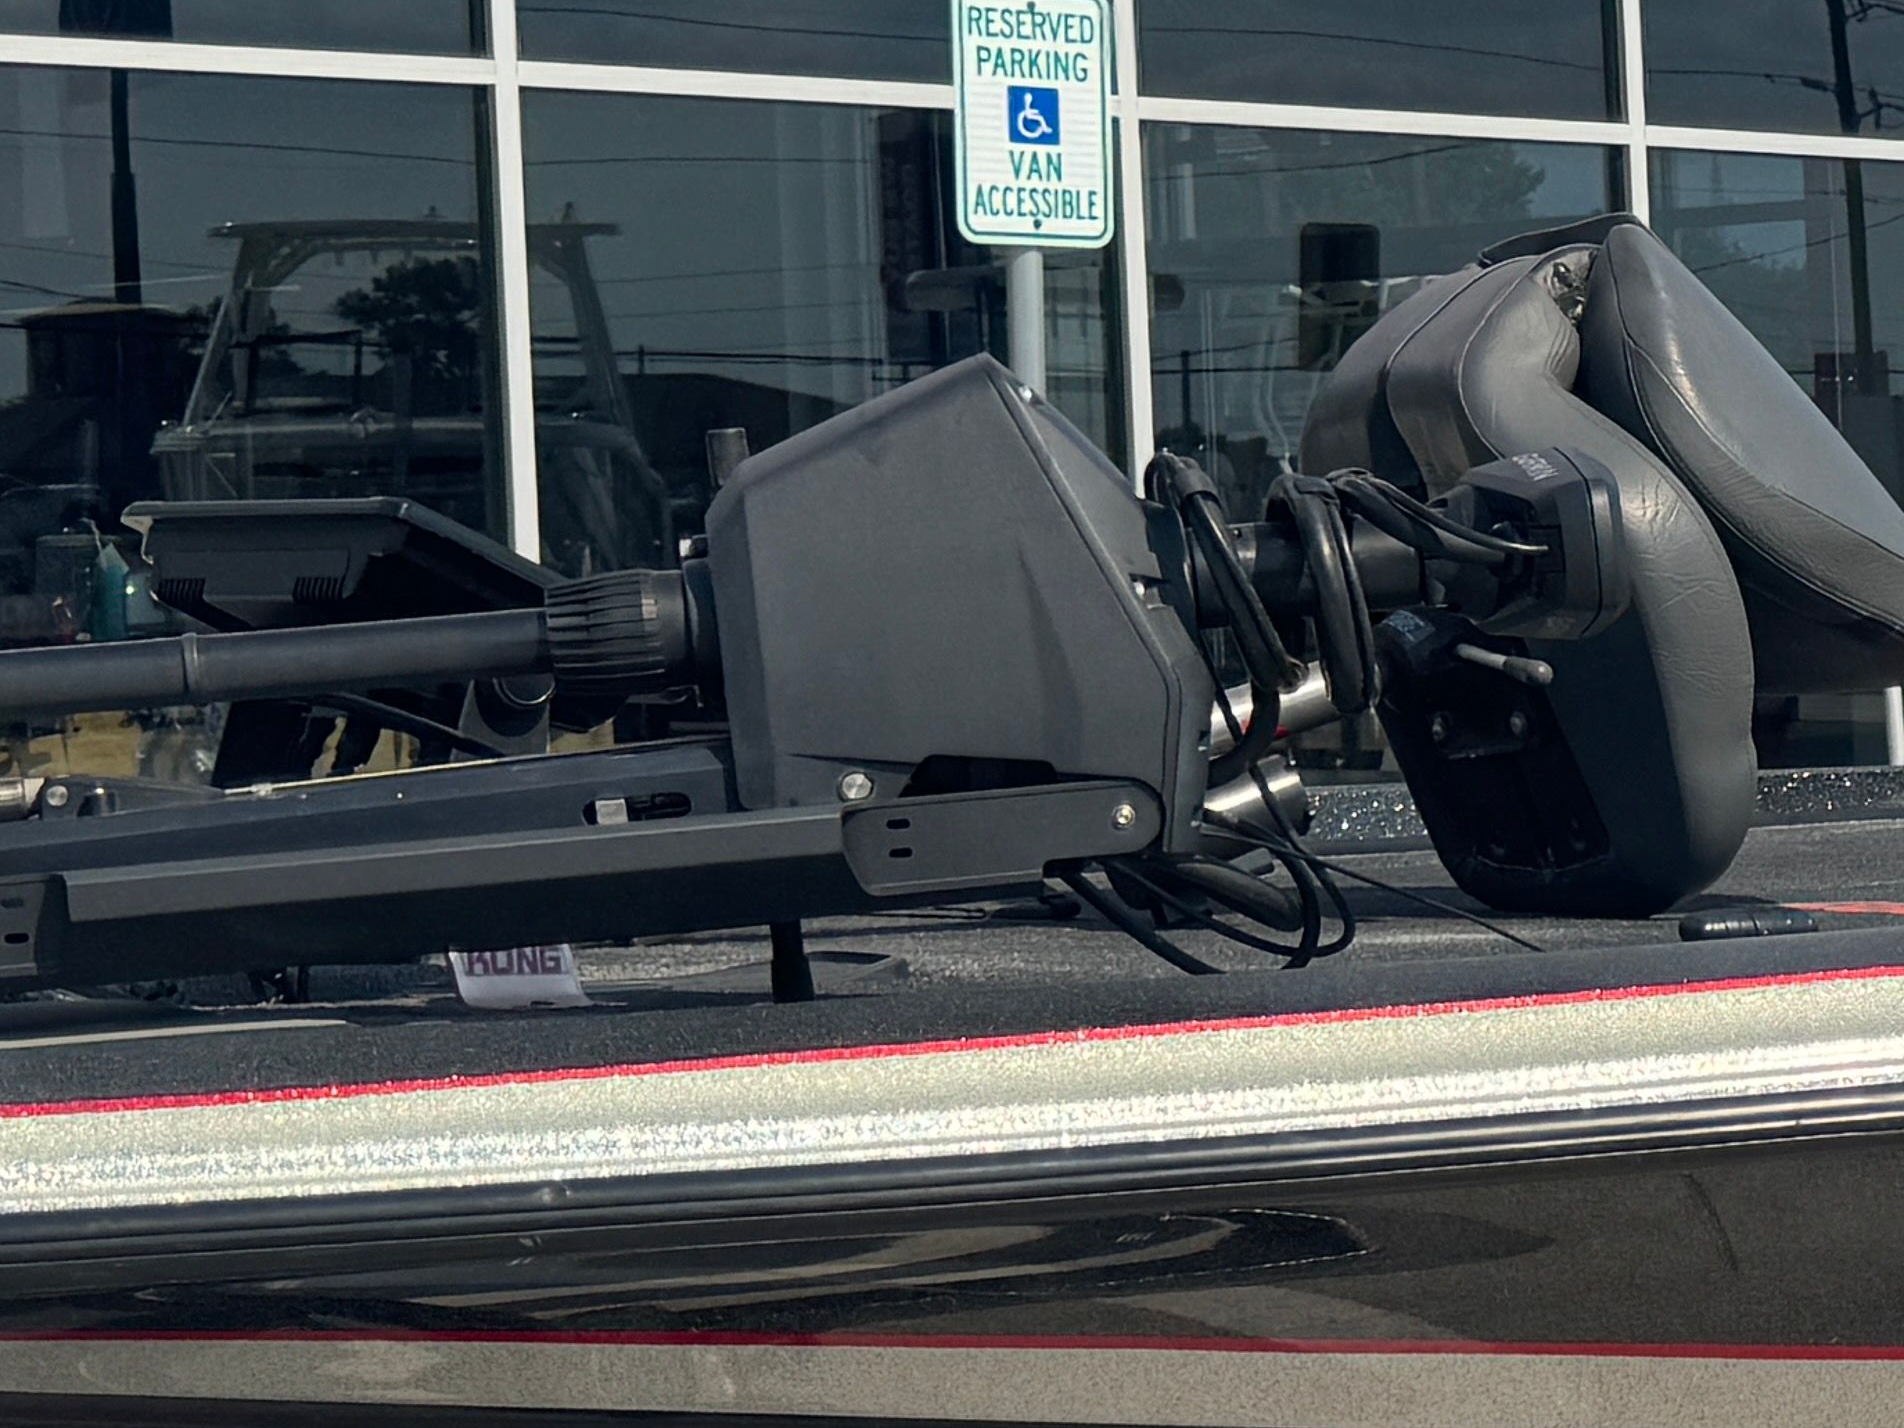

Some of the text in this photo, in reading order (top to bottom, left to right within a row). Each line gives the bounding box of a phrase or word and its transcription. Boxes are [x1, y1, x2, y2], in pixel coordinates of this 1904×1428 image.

[967, 5, 1095, 45] RESERVED
[976, 45, 1089, 83] PARKING
[1009, 149, 1063, 183] VAN
[973, 183, 1100, 221] ACCESSIBLE
